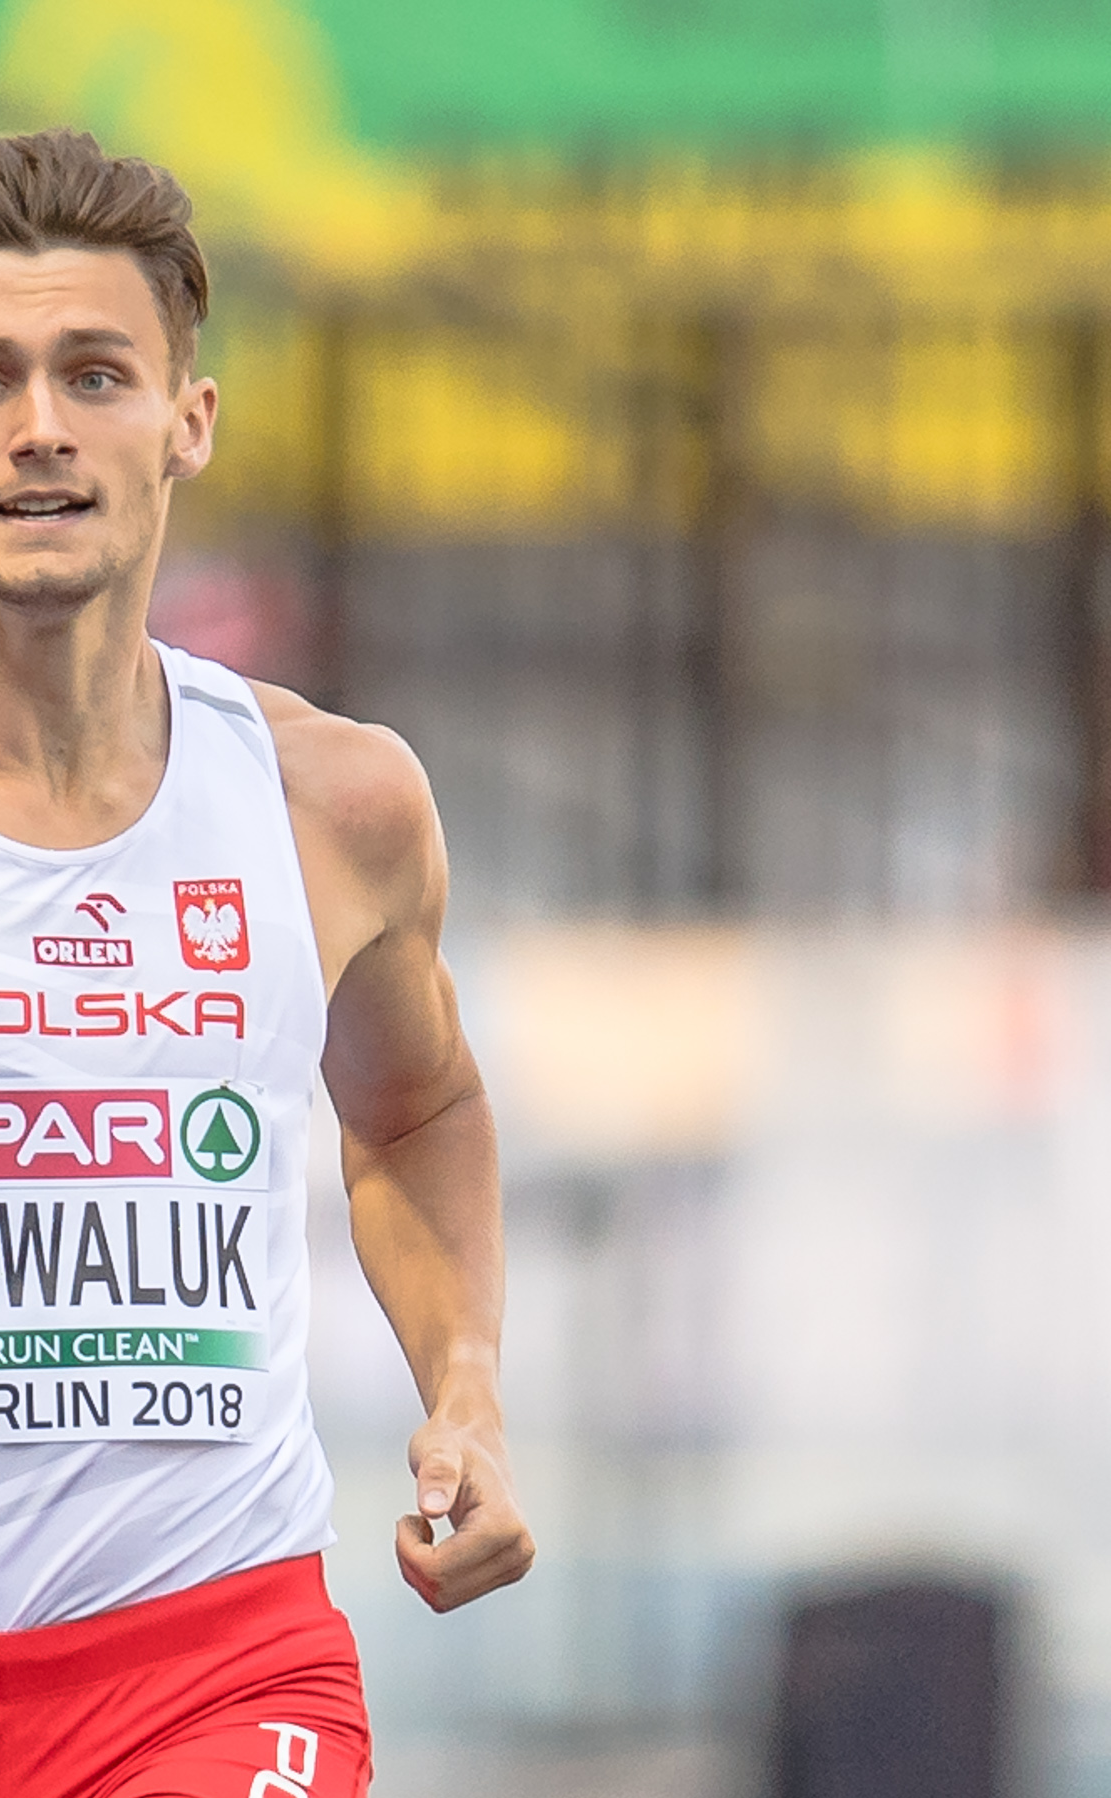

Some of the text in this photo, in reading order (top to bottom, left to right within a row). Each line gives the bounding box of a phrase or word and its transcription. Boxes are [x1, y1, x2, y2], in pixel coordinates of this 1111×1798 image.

[177, 882, 239, 896] POLSKA
[38, 940, 128, 964] ORLEN
[131, 1380, 244, 1429] 2018
